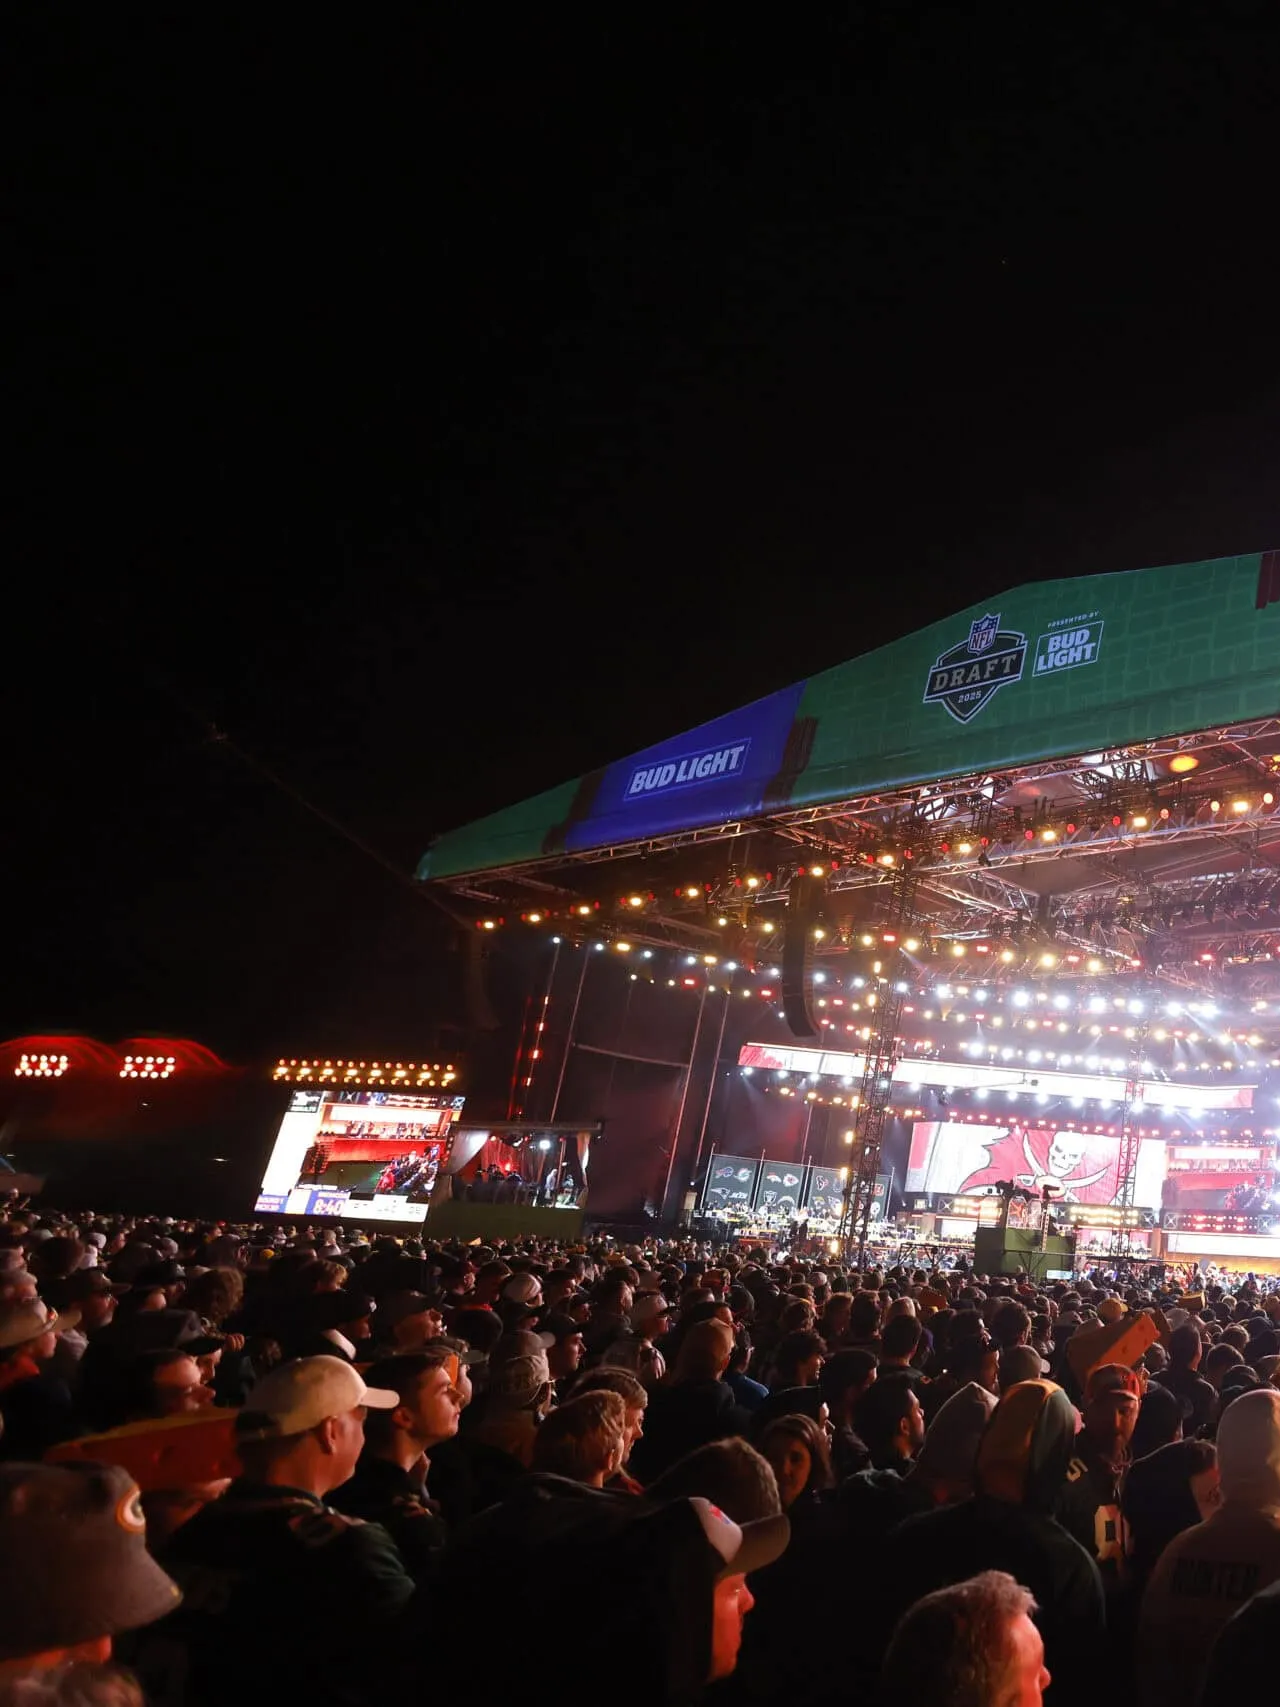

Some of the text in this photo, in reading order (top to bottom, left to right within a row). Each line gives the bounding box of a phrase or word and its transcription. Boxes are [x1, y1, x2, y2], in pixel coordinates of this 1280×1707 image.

[1047, 610, 1099, 629] PRESENTED BY
[970, 629, 995, 650] NFL
[1047, 629, 1090, 653] BUD
[1037, 643, 1096, 671] LIGHT
[933, 654, 1018, 692] DRAFT
[958, 691, 982, 703] 2025
[629, 746, 745, 794] BUD LIGHT
